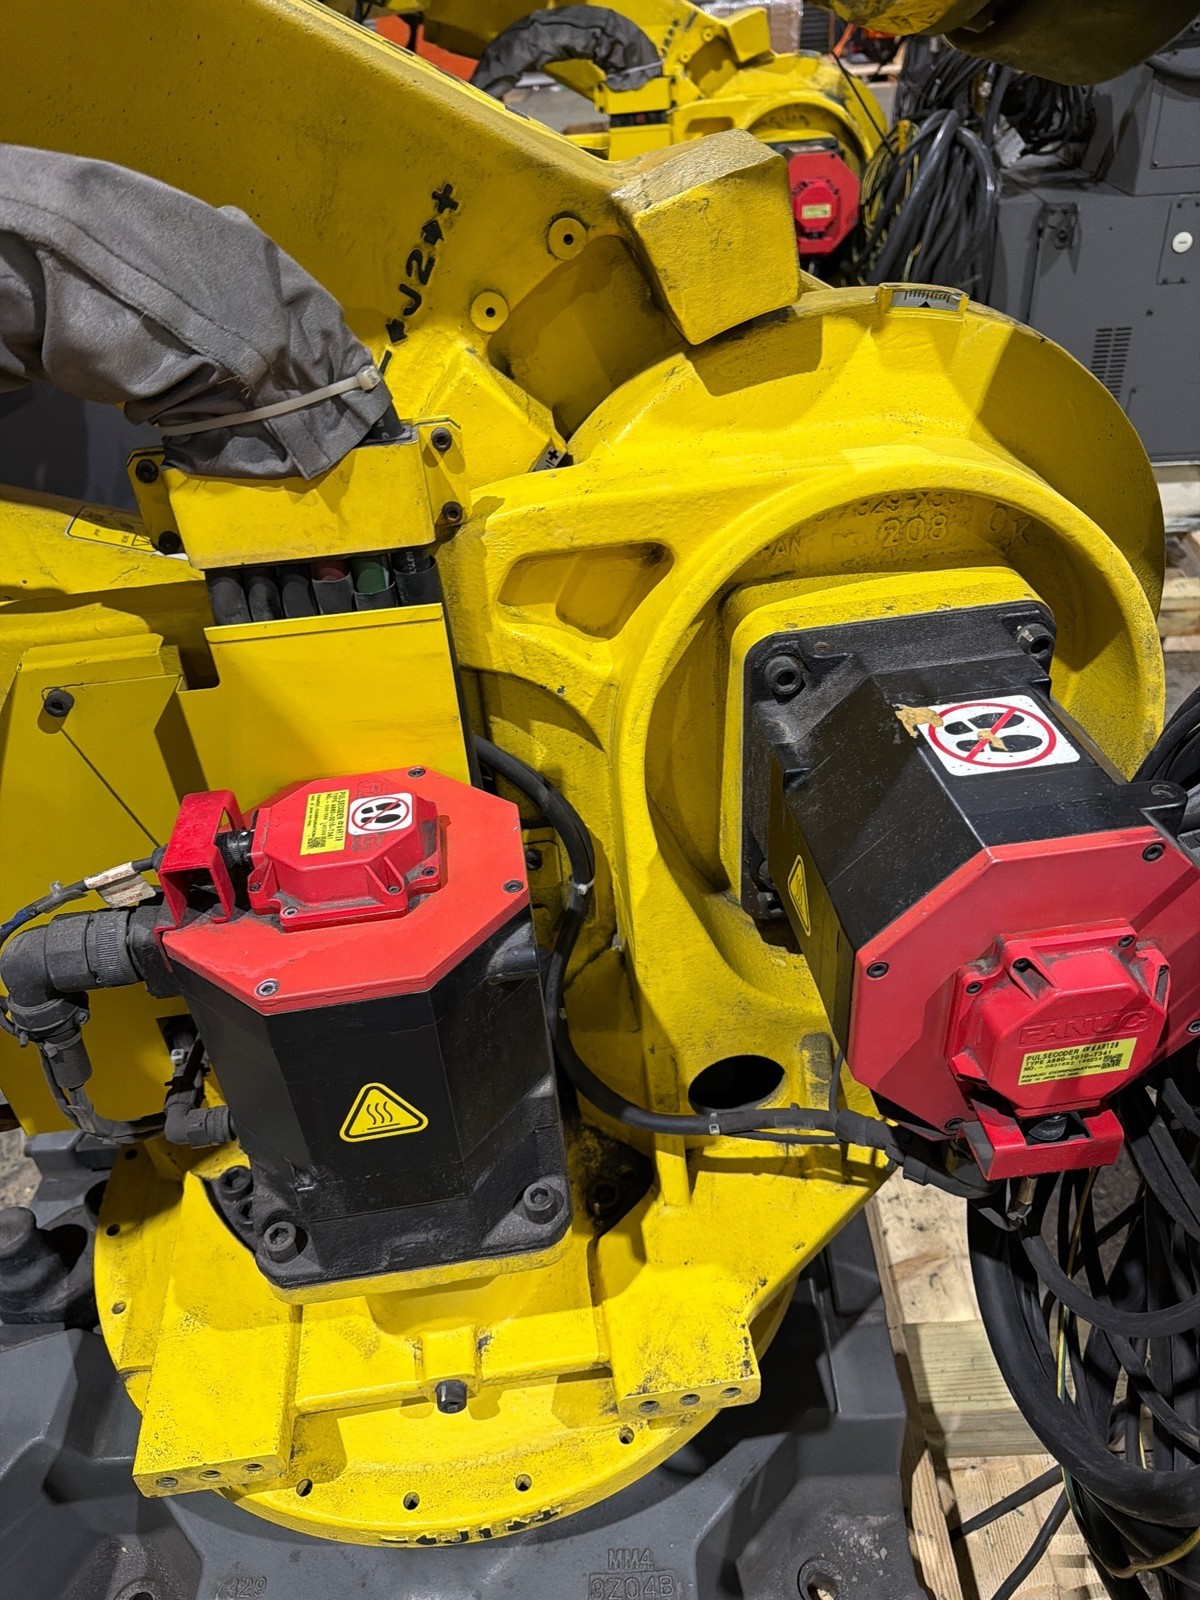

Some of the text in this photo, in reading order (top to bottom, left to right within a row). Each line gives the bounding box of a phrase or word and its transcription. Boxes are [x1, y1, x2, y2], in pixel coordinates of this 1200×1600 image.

[398, 249, 436, 316] J2
[882, 513, 947, 547] 208
[1019, 1011, 1149, 1045] FANUC
[1026, 1048, 1080, 1061] PULSECODER
[1048, 1064, 1102, 1075] CORPORATION
[607, 1547, 655, 1571] MM4
